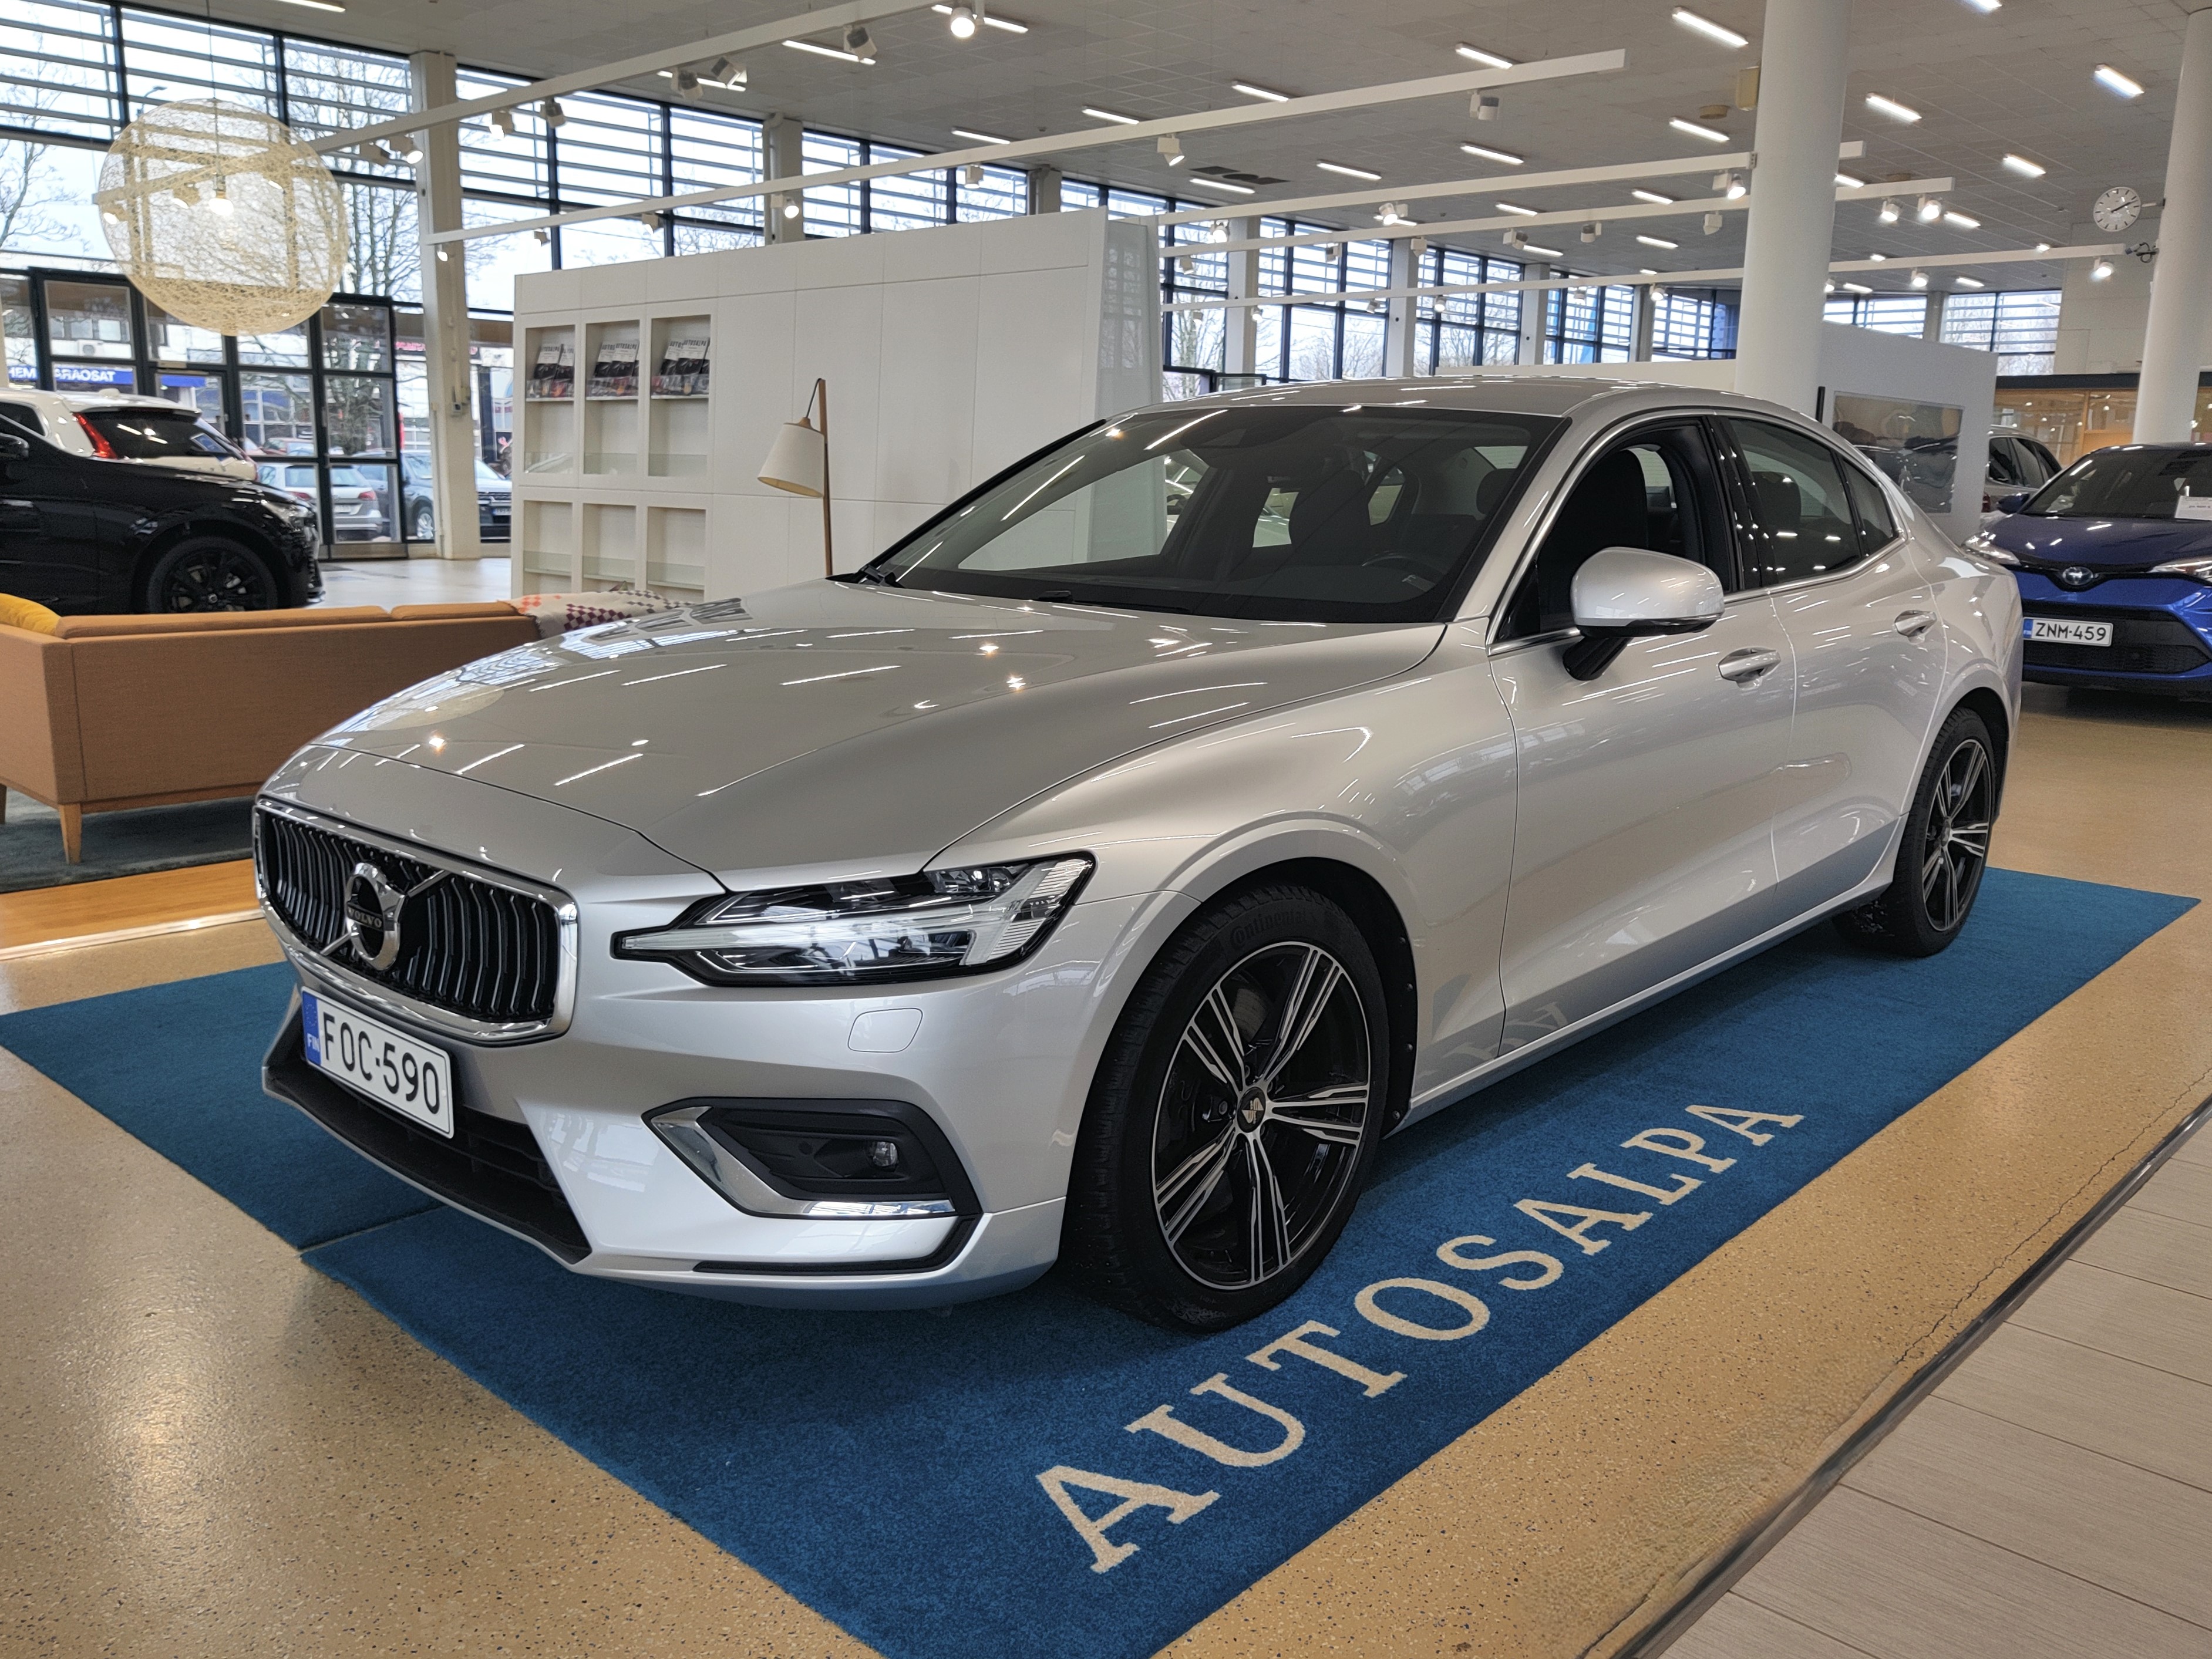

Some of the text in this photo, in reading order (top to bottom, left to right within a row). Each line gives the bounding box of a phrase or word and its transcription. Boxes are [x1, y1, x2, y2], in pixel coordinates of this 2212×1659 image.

[2035, 622, 2106, 641] ZNM-459
[348, 906, 382, 928] VOLVO
[307, 1033, 320, 1053] FIN
[324, 1011, 440, 1114] FOC-590
[1035, 1104, 1804, 1573] AUTOSALPA
